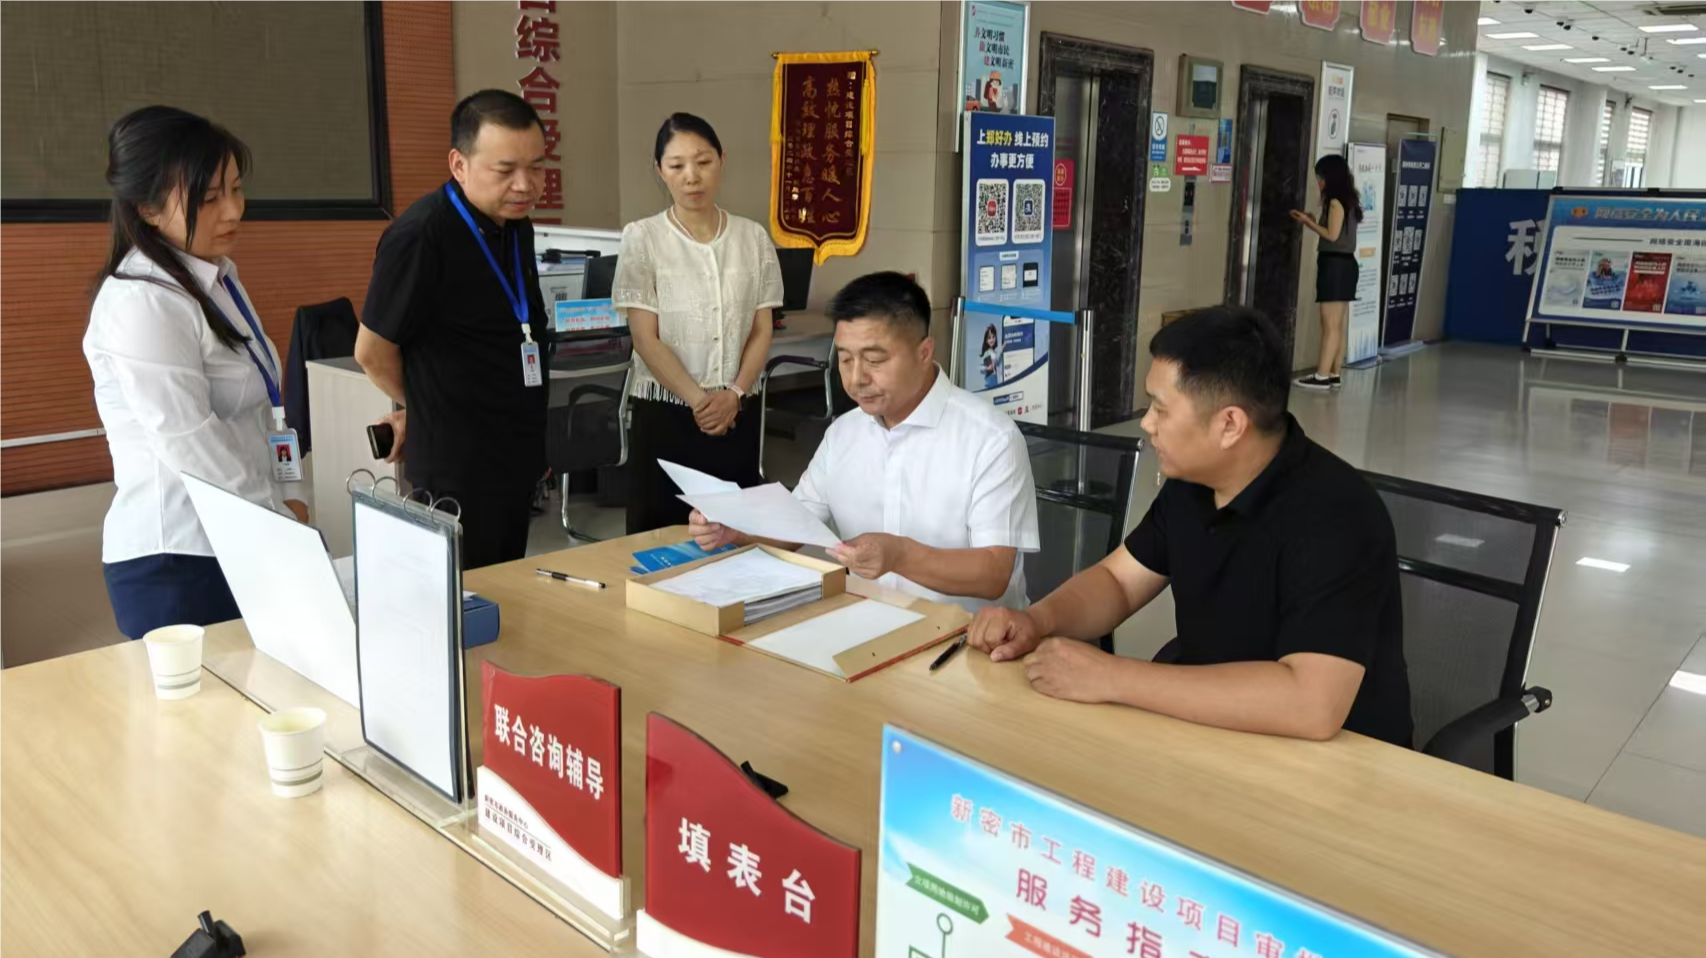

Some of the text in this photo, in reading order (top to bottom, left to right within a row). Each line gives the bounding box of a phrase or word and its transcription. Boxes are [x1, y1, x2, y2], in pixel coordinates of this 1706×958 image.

[977, 129, 1049, 148] 上郑好办 线上预约
[990, 152, 1035, 169] 办事更方便
[494, 703, 605, 801] 联合咨询辅导
[485, 808, 552, 861] 建设项目综合受理区
[678, 817, 816, 924] 填表台
[951, 794, 1322, 958] 新密市工程建设项目审
[1016, 868, 1210, 958] 服务指
